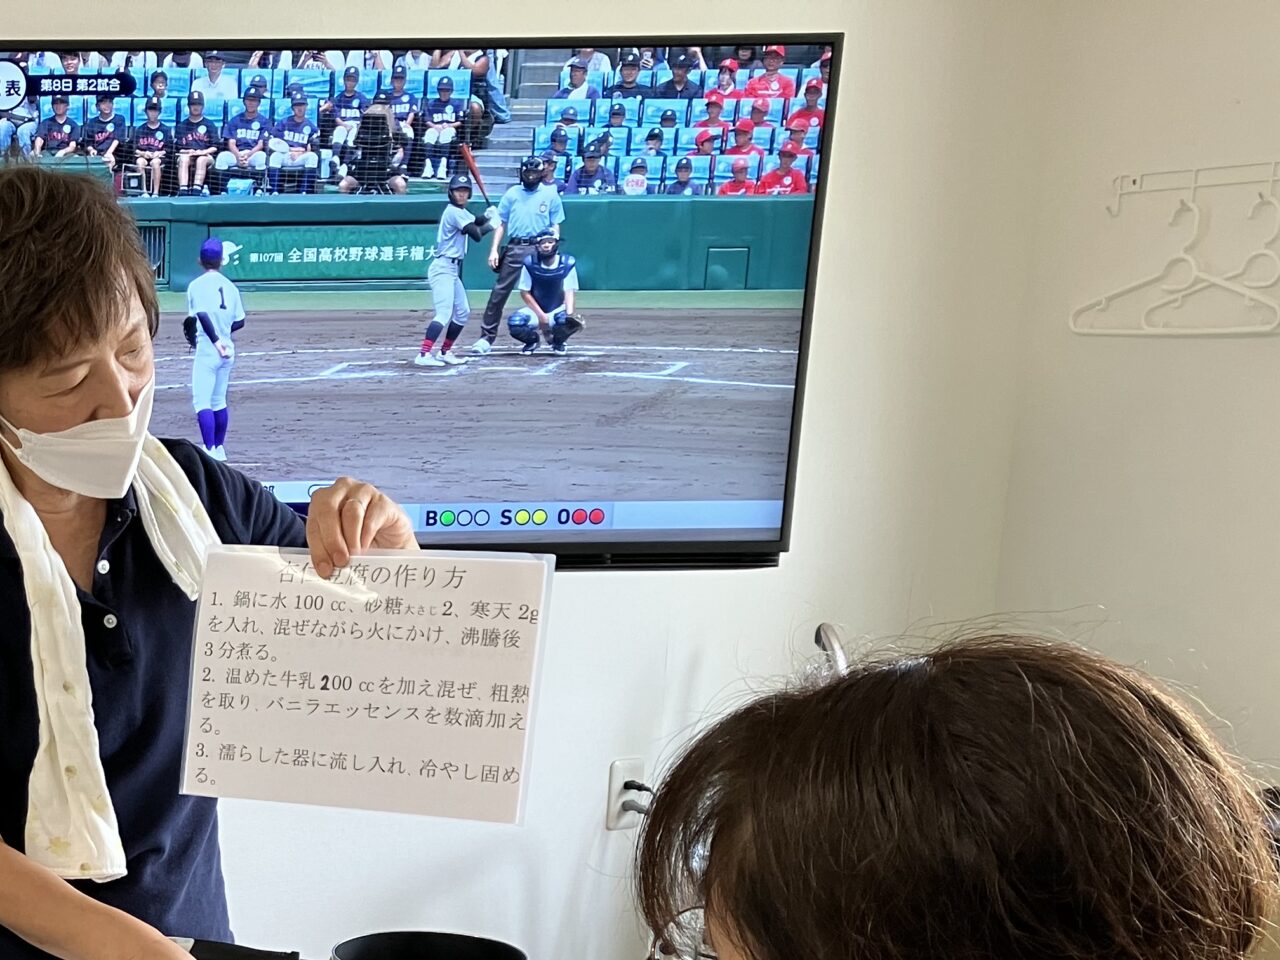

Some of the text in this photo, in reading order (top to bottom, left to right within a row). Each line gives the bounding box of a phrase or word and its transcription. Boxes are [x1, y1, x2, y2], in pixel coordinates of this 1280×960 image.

[39, 78, 73, 92] 第8日
[75, 78, 121, 92] 第2試合
[249, 252, 284, 263] 第107回
[218, 286, 227, 310] 1
[425, 510, 438, 527] B
[500, 509, 513, 525] S
[207, 614, 521, 649] を入れ、混ぜながら火にかけ、沸騰後
[199, 716, 221, 736] る。
[194, 767, 217, 786] る。
